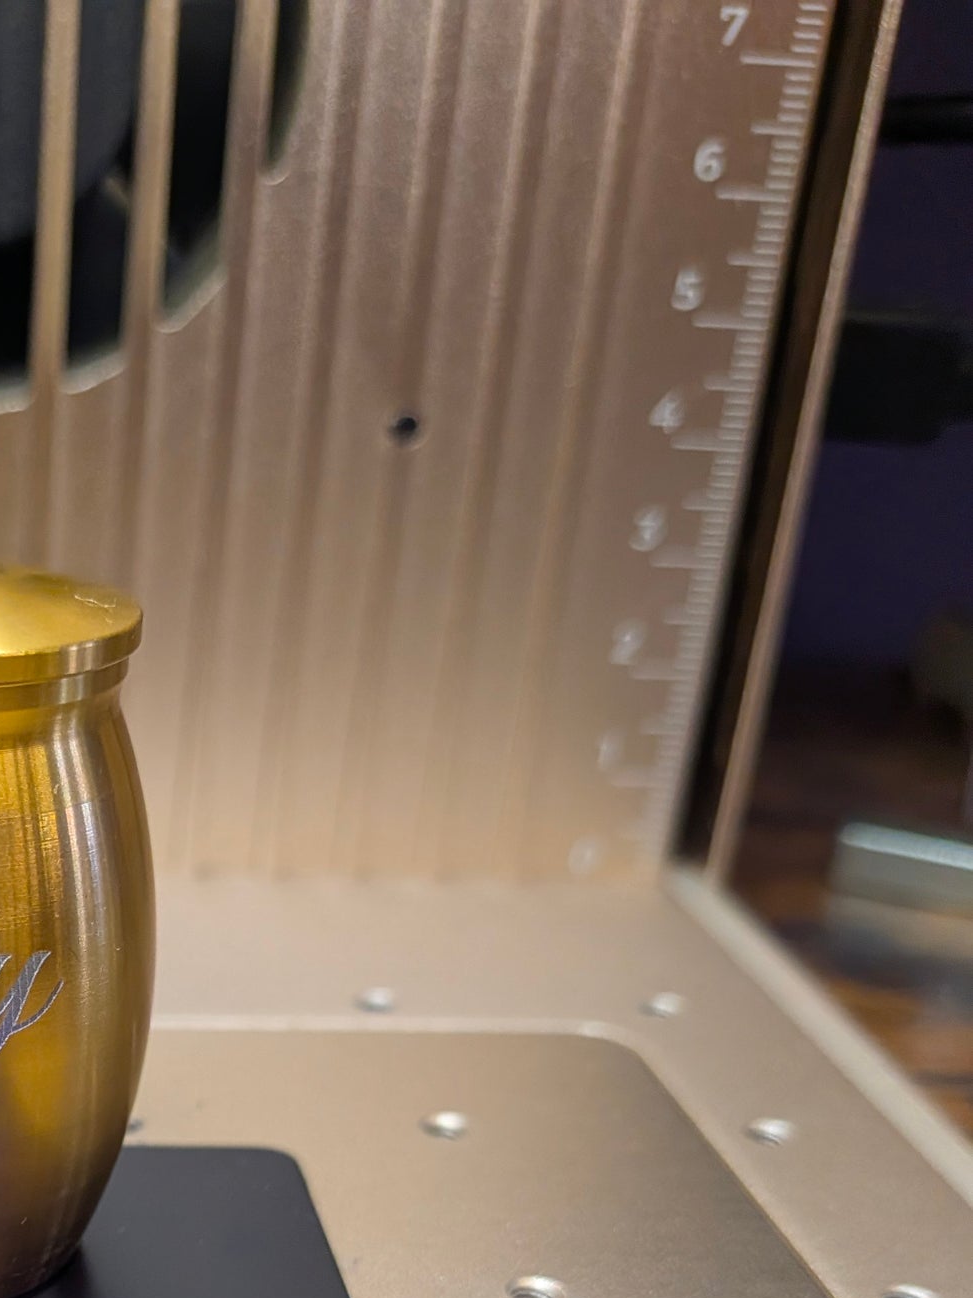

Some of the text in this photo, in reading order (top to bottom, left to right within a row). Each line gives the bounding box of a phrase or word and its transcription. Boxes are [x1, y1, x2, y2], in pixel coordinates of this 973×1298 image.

[720, 5, 750, 47] 7
[693, 138, 725, 183] 6
[670, 265, 704, 312] 5
